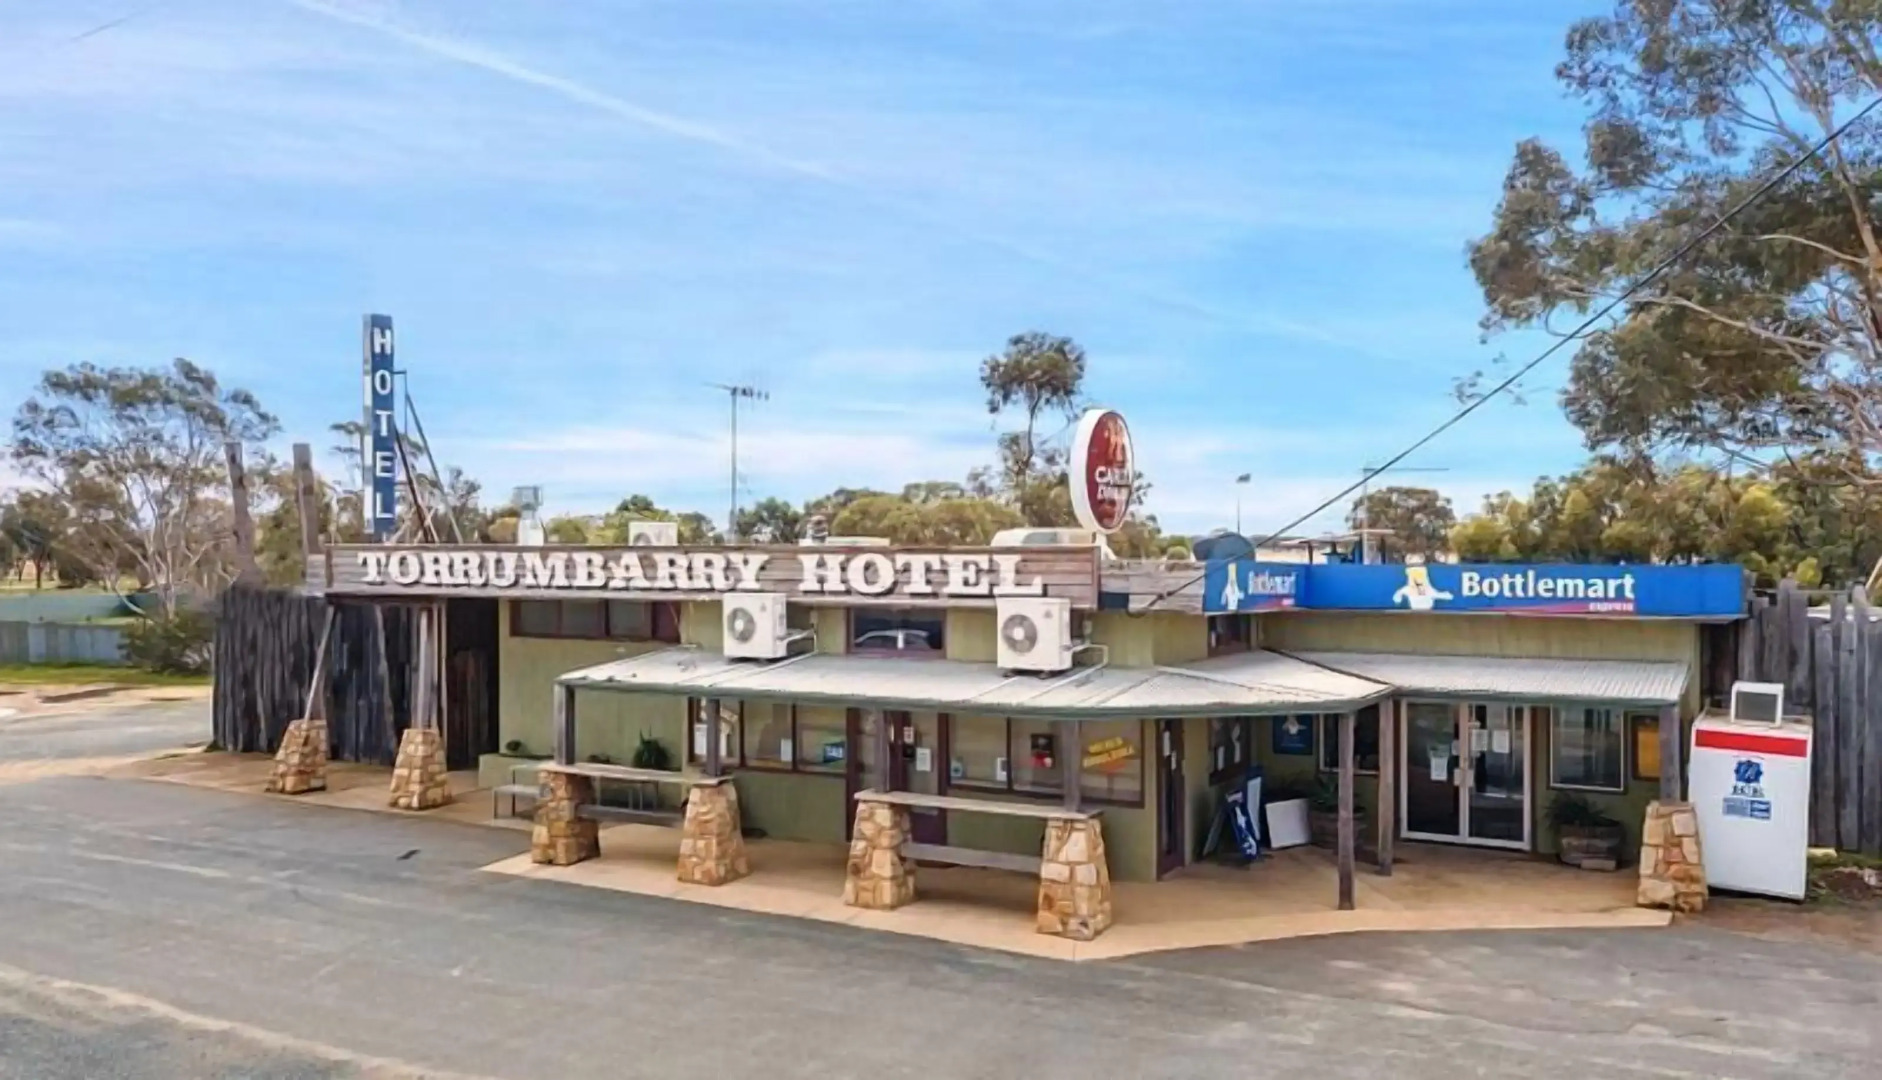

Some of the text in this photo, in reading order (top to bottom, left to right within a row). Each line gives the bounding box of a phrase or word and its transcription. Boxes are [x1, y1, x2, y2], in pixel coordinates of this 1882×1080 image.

[373, 326, 393, 519] HOTEL
[357, 551, 1045, 596] TORRUMBARRY HOTEL
[1461, 569, 1635, 599] Bottlemart
